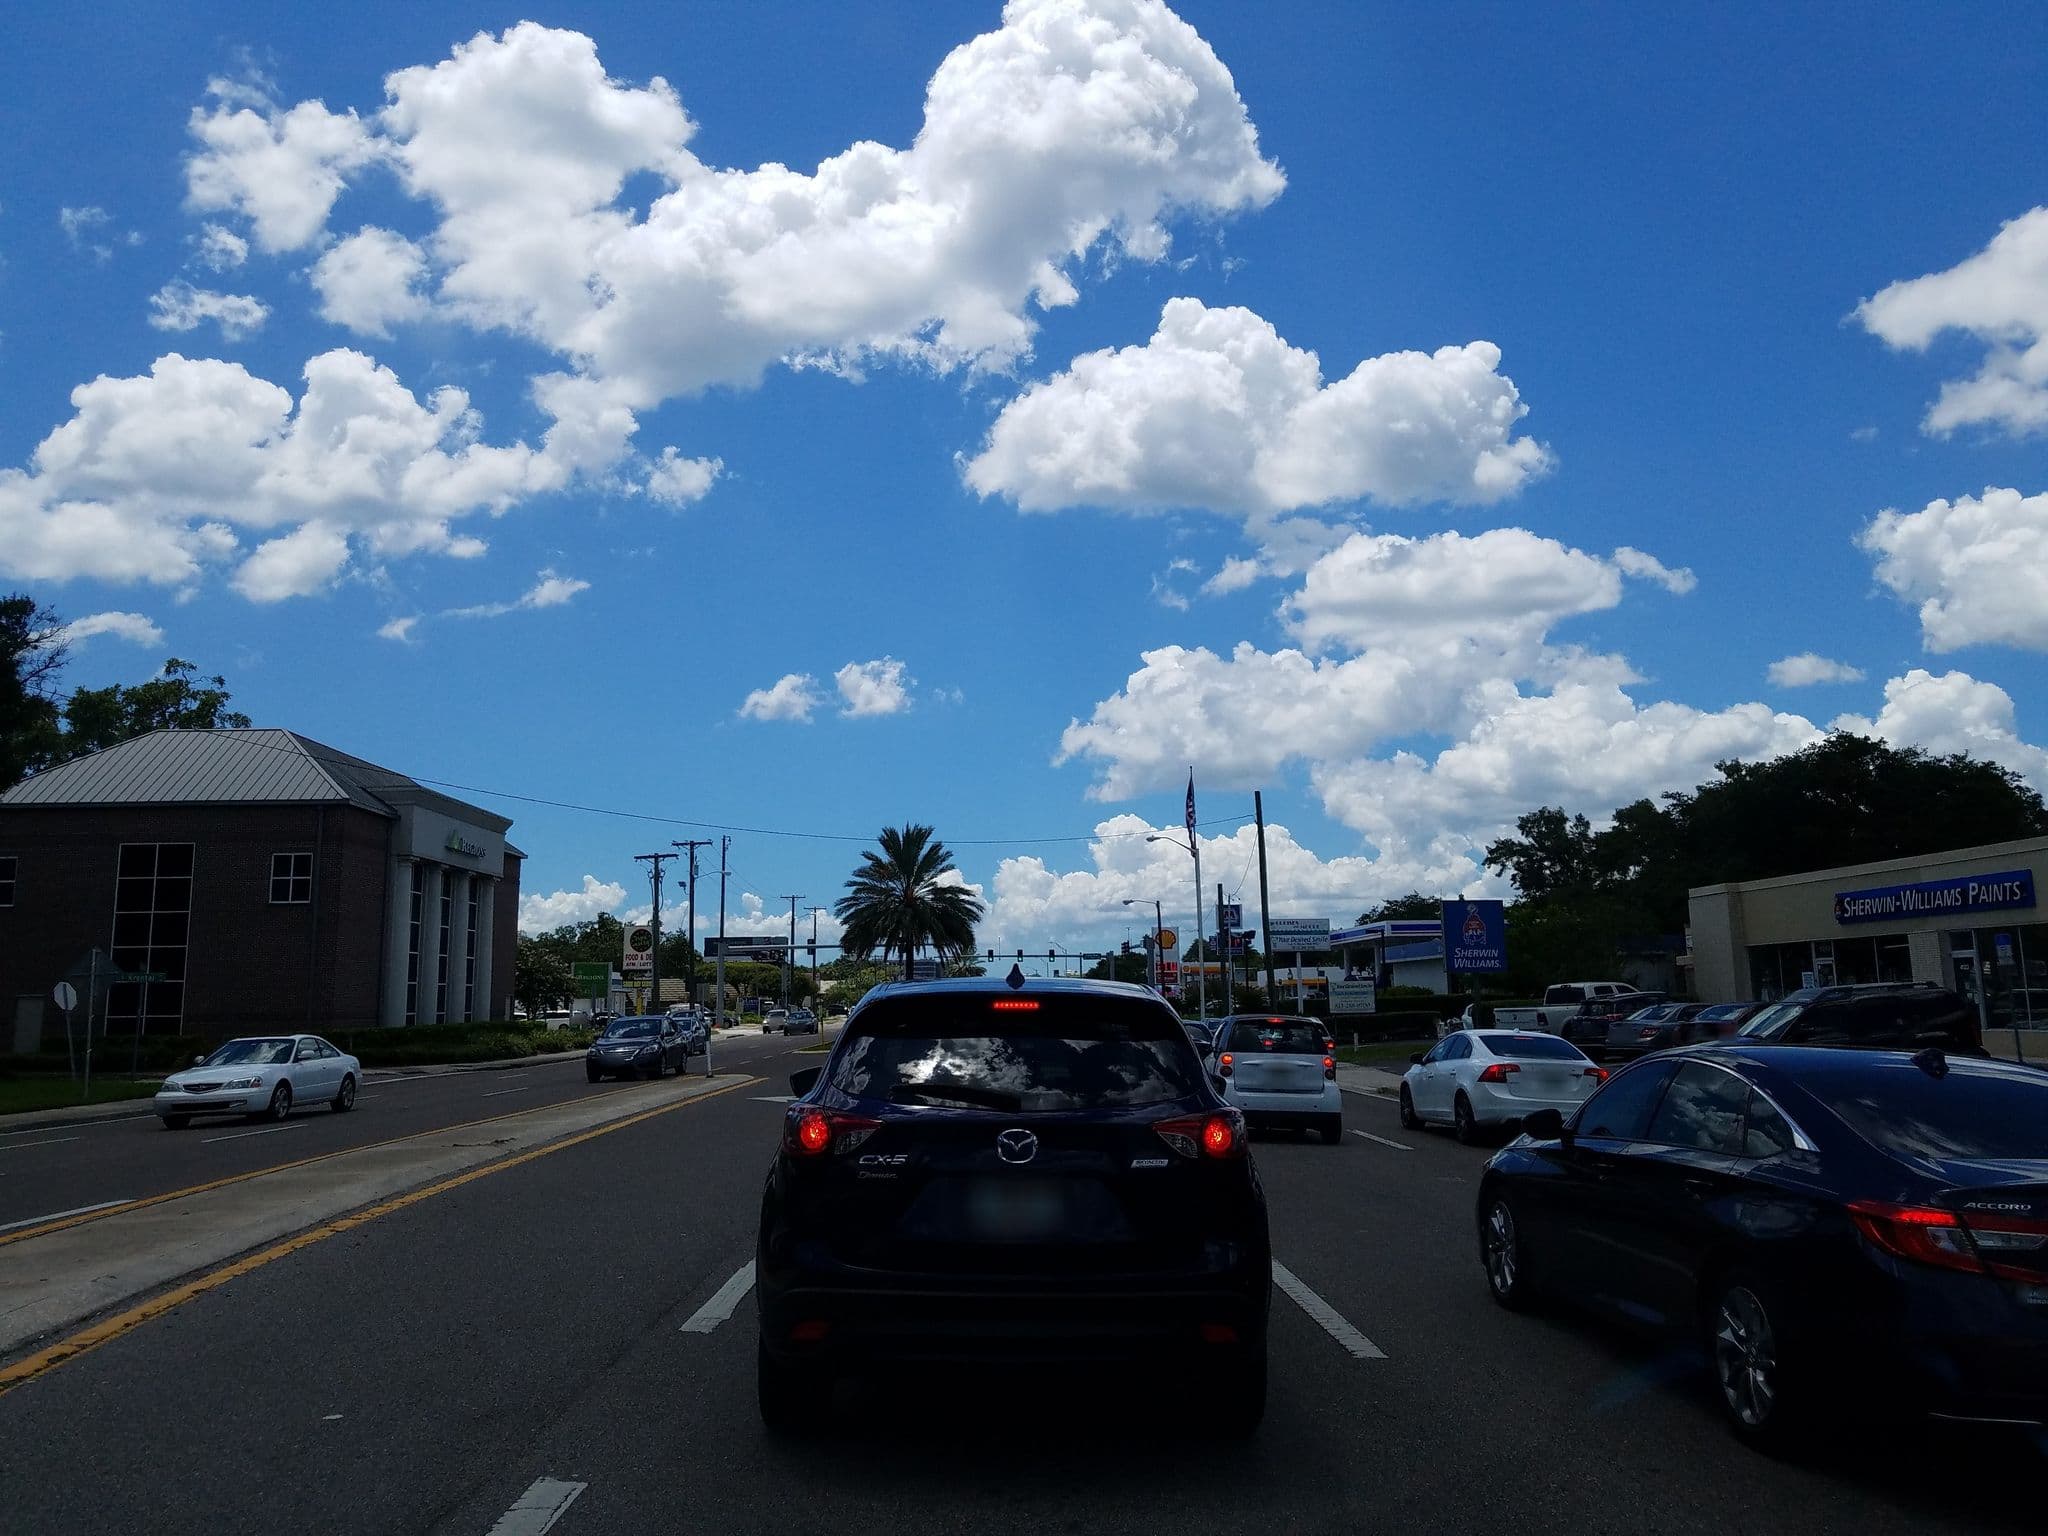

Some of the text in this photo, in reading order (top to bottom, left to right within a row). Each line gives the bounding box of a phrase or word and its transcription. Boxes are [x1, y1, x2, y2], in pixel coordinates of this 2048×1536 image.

[1968, 881, 2021, 905] PAINTS
[1454, 947, 1499, 958] SHERWIN
[1454, 958, 1500, 969] WILLIAMS
[858, 1154, 909, 1166] CX-5
[1963, 1202, 2032, 1211] ACCORD
